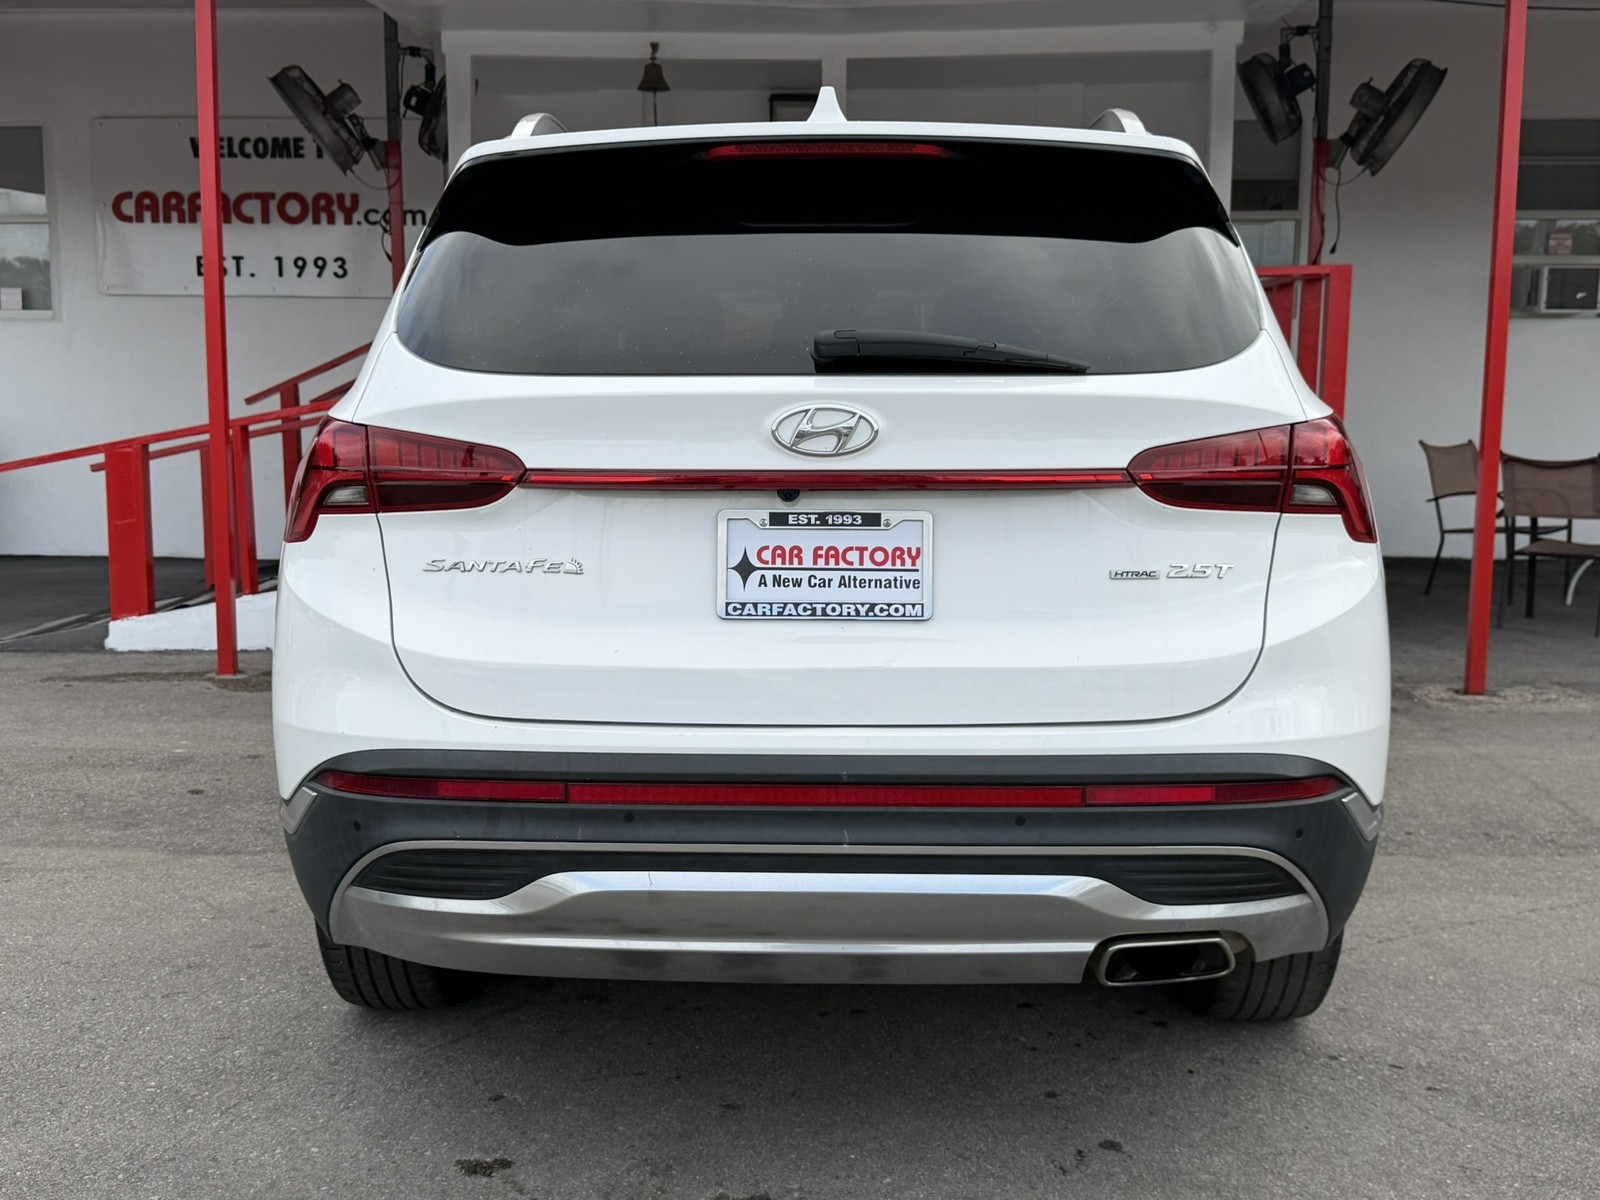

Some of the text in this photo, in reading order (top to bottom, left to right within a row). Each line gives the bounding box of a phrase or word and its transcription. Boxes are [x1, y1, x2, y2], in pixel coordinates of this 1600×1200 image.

[274, 255, 349, 279] 1993
[788, 514, 863, 525] EST. 1993
[756, 545, 922, 567] CAR FACTORY
[1114, 570, 1157, 578] HTRAC
[758, 574, 921, 590] A New Car Alternative
[727, 603, 923, 617] CARFACTORY.COM
